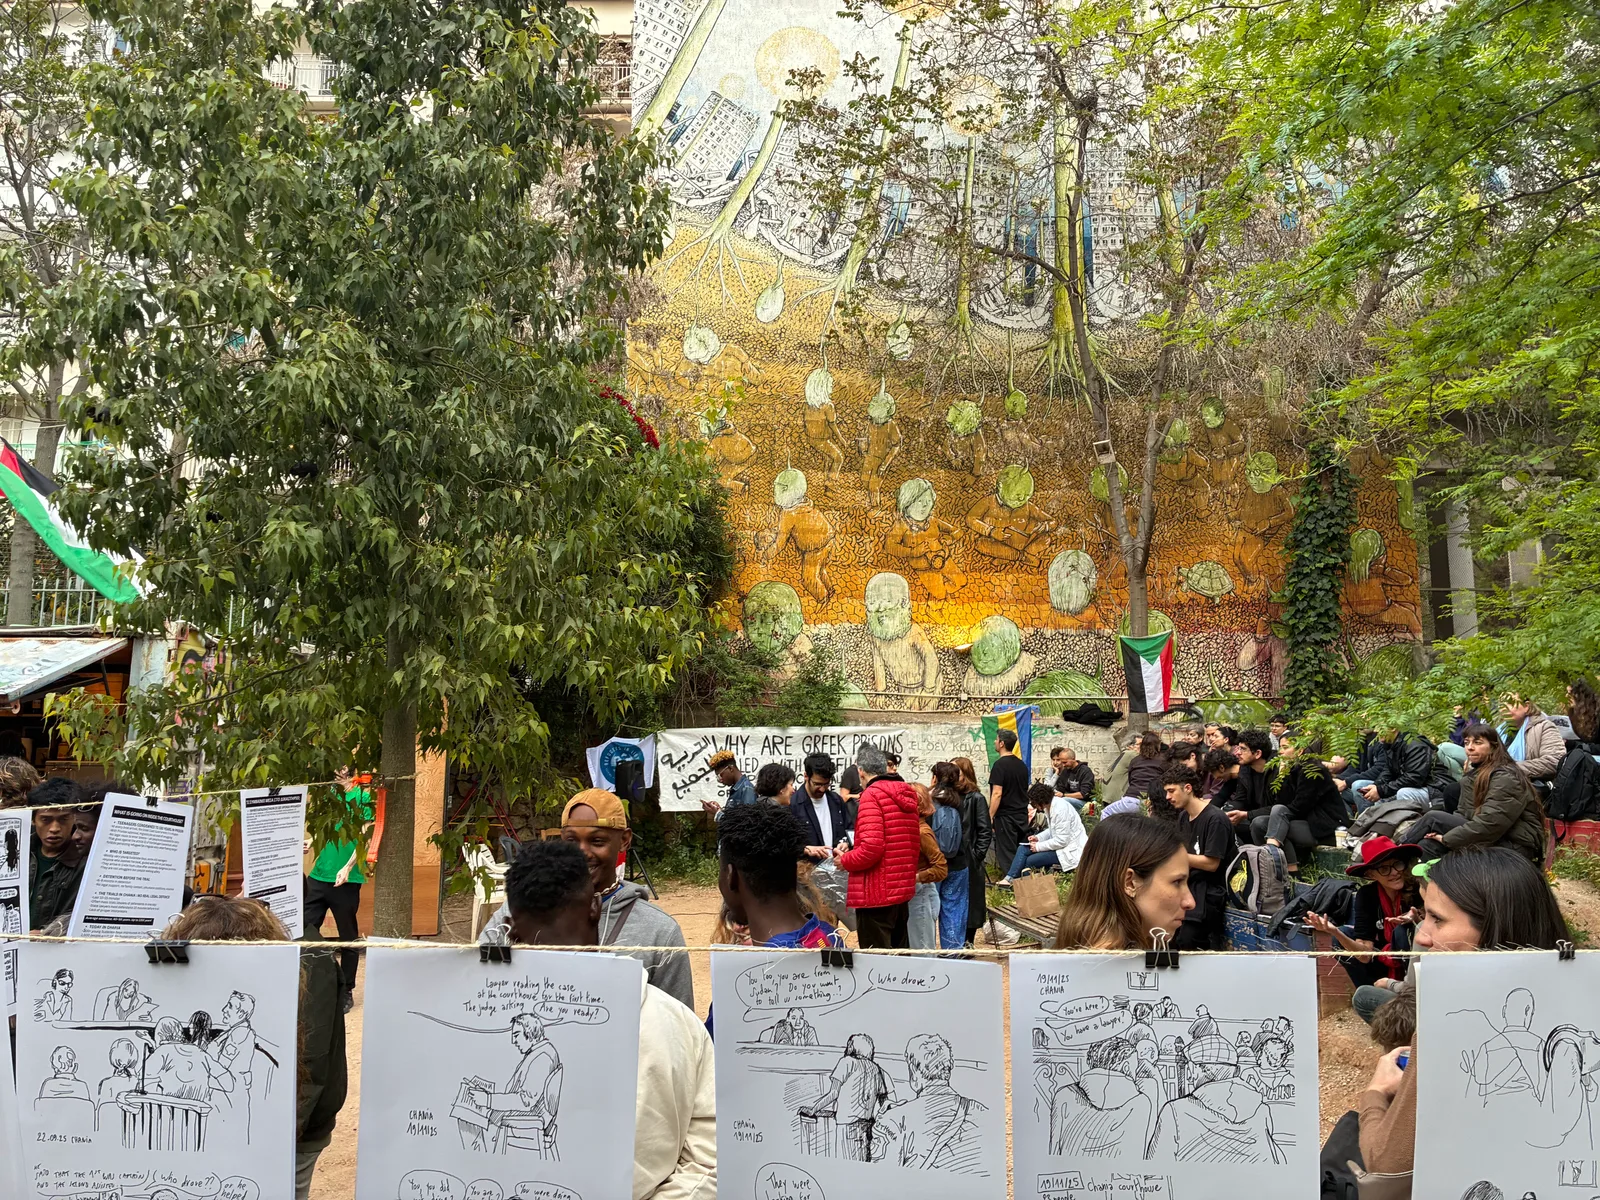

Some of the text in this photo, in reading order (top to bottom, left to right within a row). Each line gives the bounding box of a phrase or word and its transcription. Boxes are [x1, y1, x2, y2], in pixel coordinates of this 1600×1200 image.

[711, 735, 750, 756] WHY
[761, 735, 793, 756] ARE
[801, 734, 847, 756] GREEK
[745, 971, 758, 985] You
[778, 973, 789, 986] you
[814, 965, 831, 978] from
[878, 973, 897, 984] Who
[513, 975, 540, 995] reading
[544, 976, 555, 990] the
[558, 984, 576, 992] case
[788, 983, 797, 992] Do
[802, 983, 816, 994] you
[477, 990, 486, 998] at
[541, 991, 553, 1001] for
[555, 991, 565, 1002] the
[463, 1000, 525, 1016] The judge asking
[539, 1003, 600, 1021] Are you ready?
[1061, 1029, 1073, 1042] You
[1074, 1024, 1090, 1034] have
[470, 1185, 480, 1196] You
[520, 1184, 530, 1194] You
[766, 1171, 811, 1194] They were
[1087, 1177, 1114, 1192] Chania
